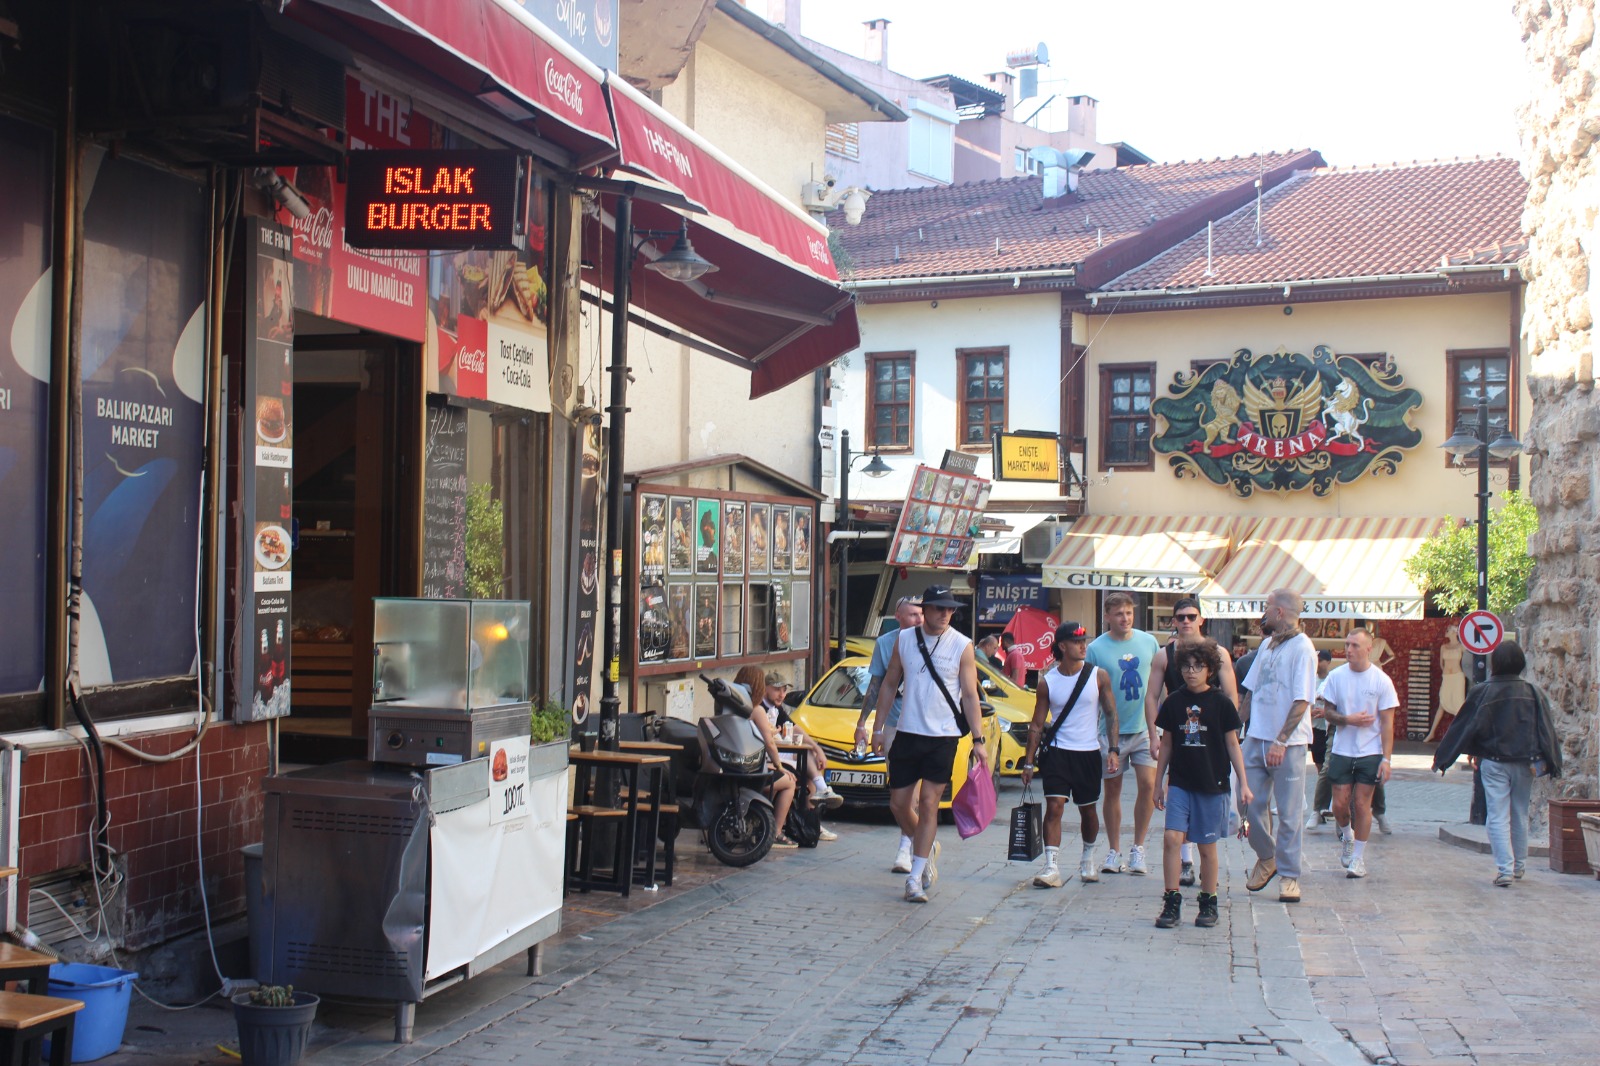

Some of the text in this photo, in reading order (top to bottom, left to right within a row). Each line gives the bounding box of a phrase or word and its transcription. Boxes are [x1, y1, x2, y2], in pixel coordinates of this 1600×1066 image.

[544, 57, 583, 116] Coca-Cola
[360, 80, 411, 147] THE
[385, 167, 474, 194] ISLAK
[367, 203, 492, 230] BURGER
[261, 227, 273, 246] THE
[370, 271, 413, 307] MAMÜLLER
[458, 345, 485, 374] Coca-Cola
[500, 340, 533, 367] Tost Çeşitleri
[506, 366, 531, 388] Coca-Cola
[97, 397, 173, 427] BALIKPAZARI
[111, 425, 159, 449] MARKET
[1237, 432, 1324, 458] ARENA
[1007, 460, 1050, 472] MARKET MANAV
[985, 583, 1039, 602] ENİŞTE
[1067, 570, 1185, 590] GÜLİZAR
[1314, 600, 1405, 614] SOUVENIR
[830, 771, 883, 785] 07 T 2381
